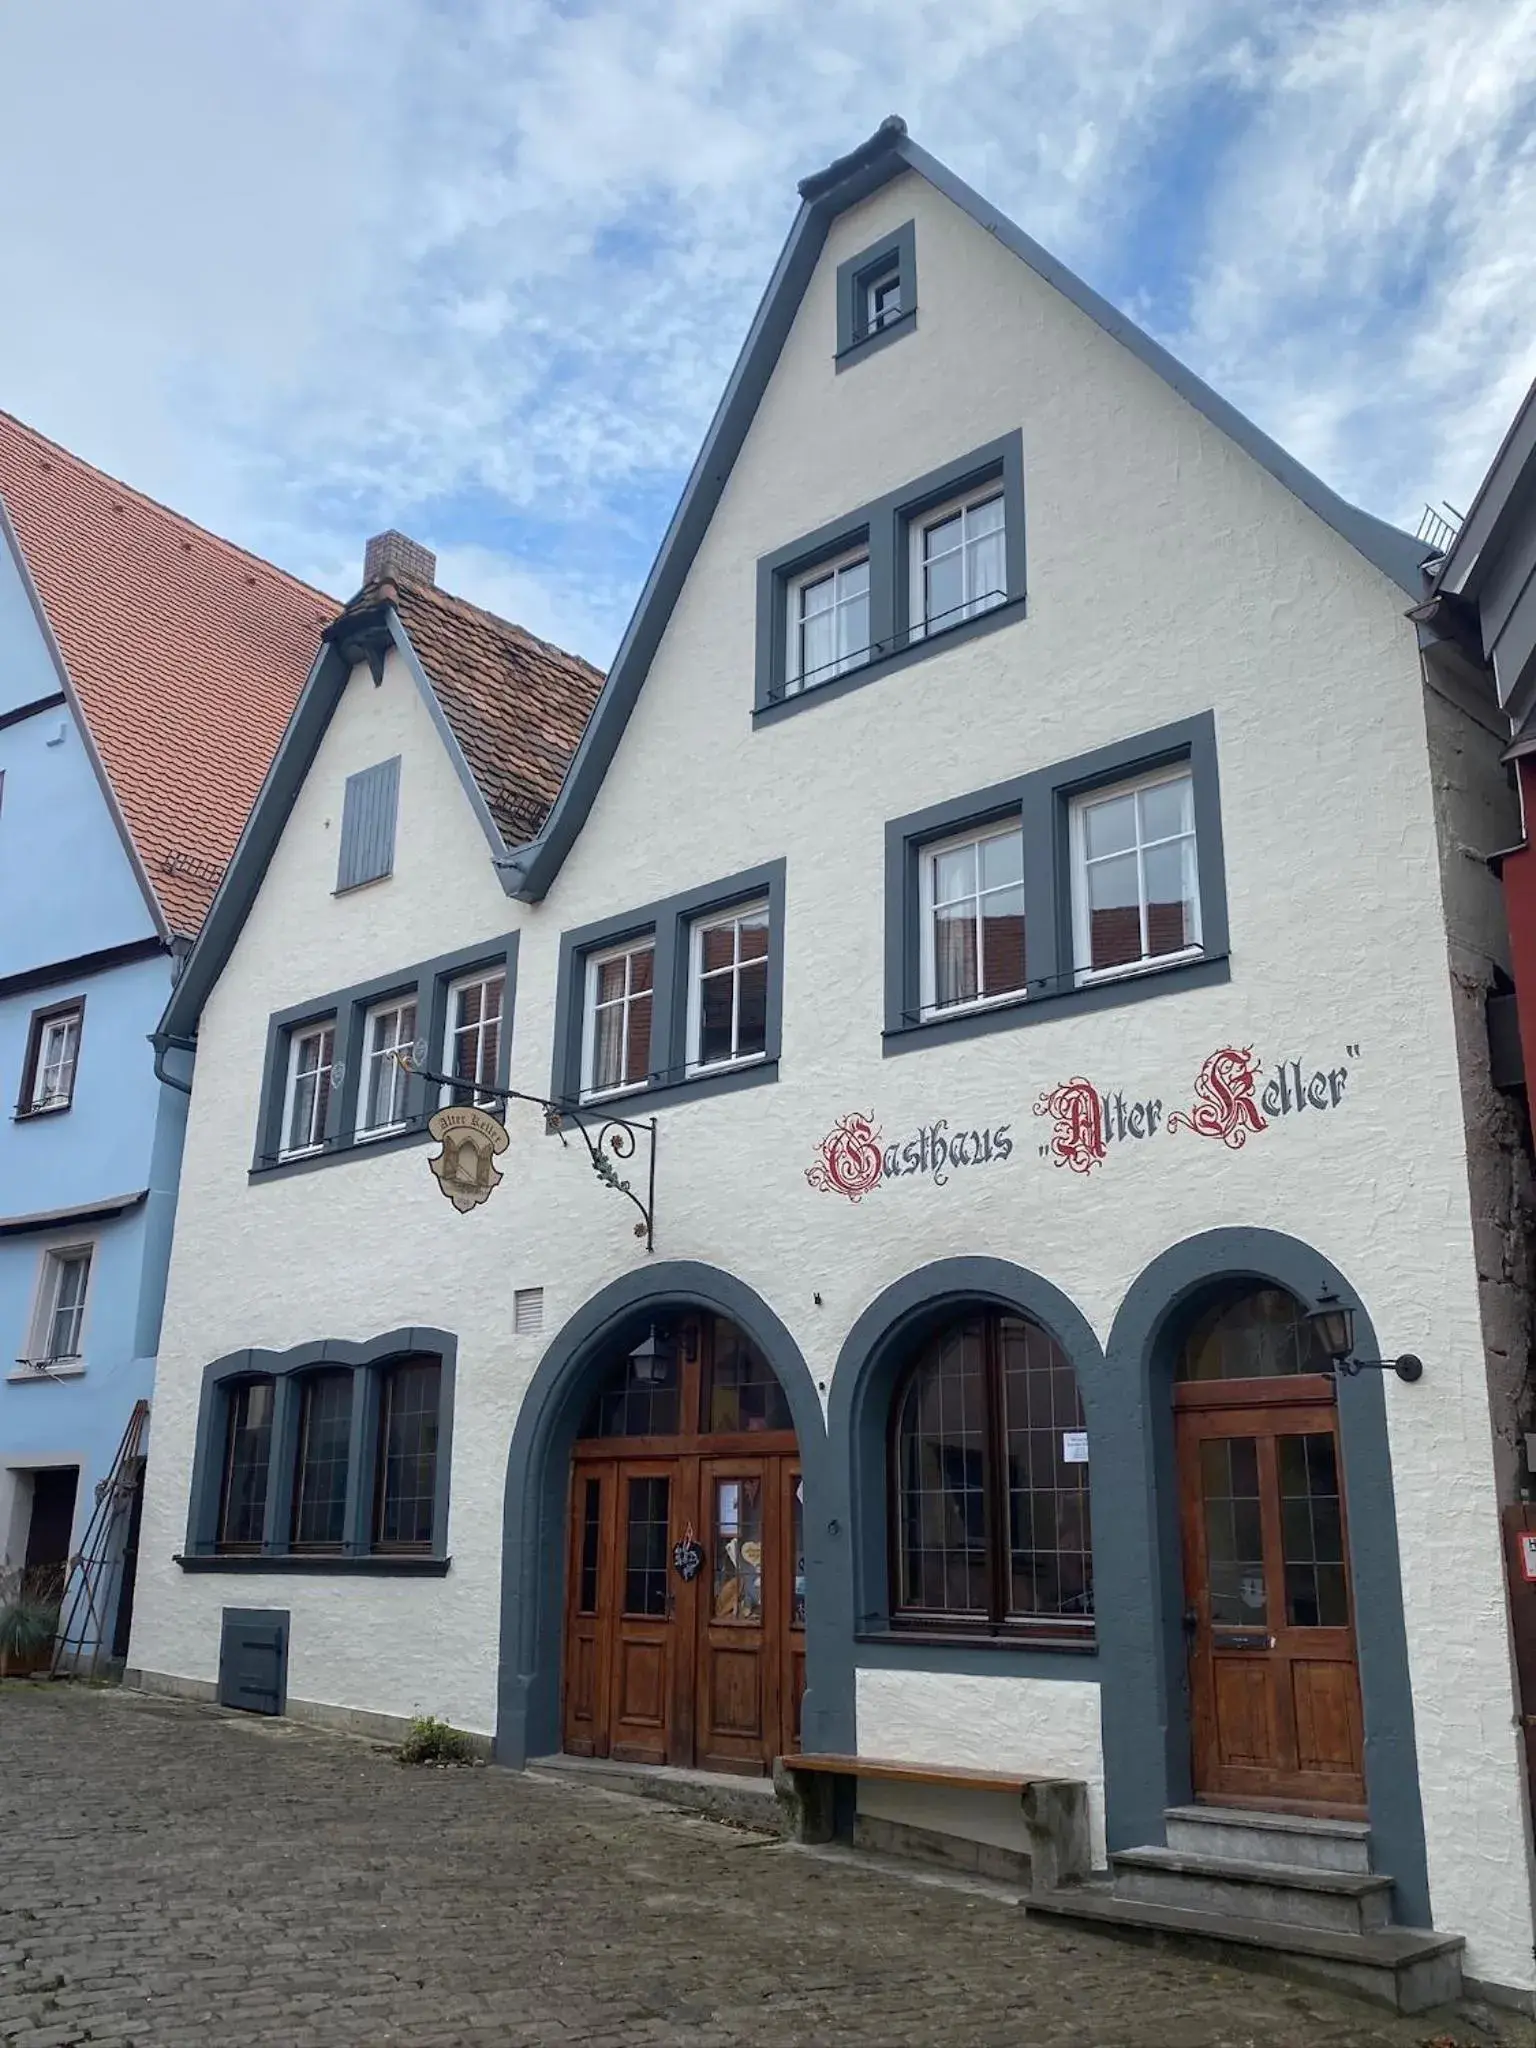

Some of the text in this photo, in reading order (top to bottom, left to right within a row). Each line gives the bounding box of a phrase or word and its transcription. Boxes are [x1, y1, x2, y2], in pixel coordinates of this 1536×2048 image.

[440, 1113, 501, 1143] Alter Keller
[804, 1108, 1013, 1203] Gasthaus
